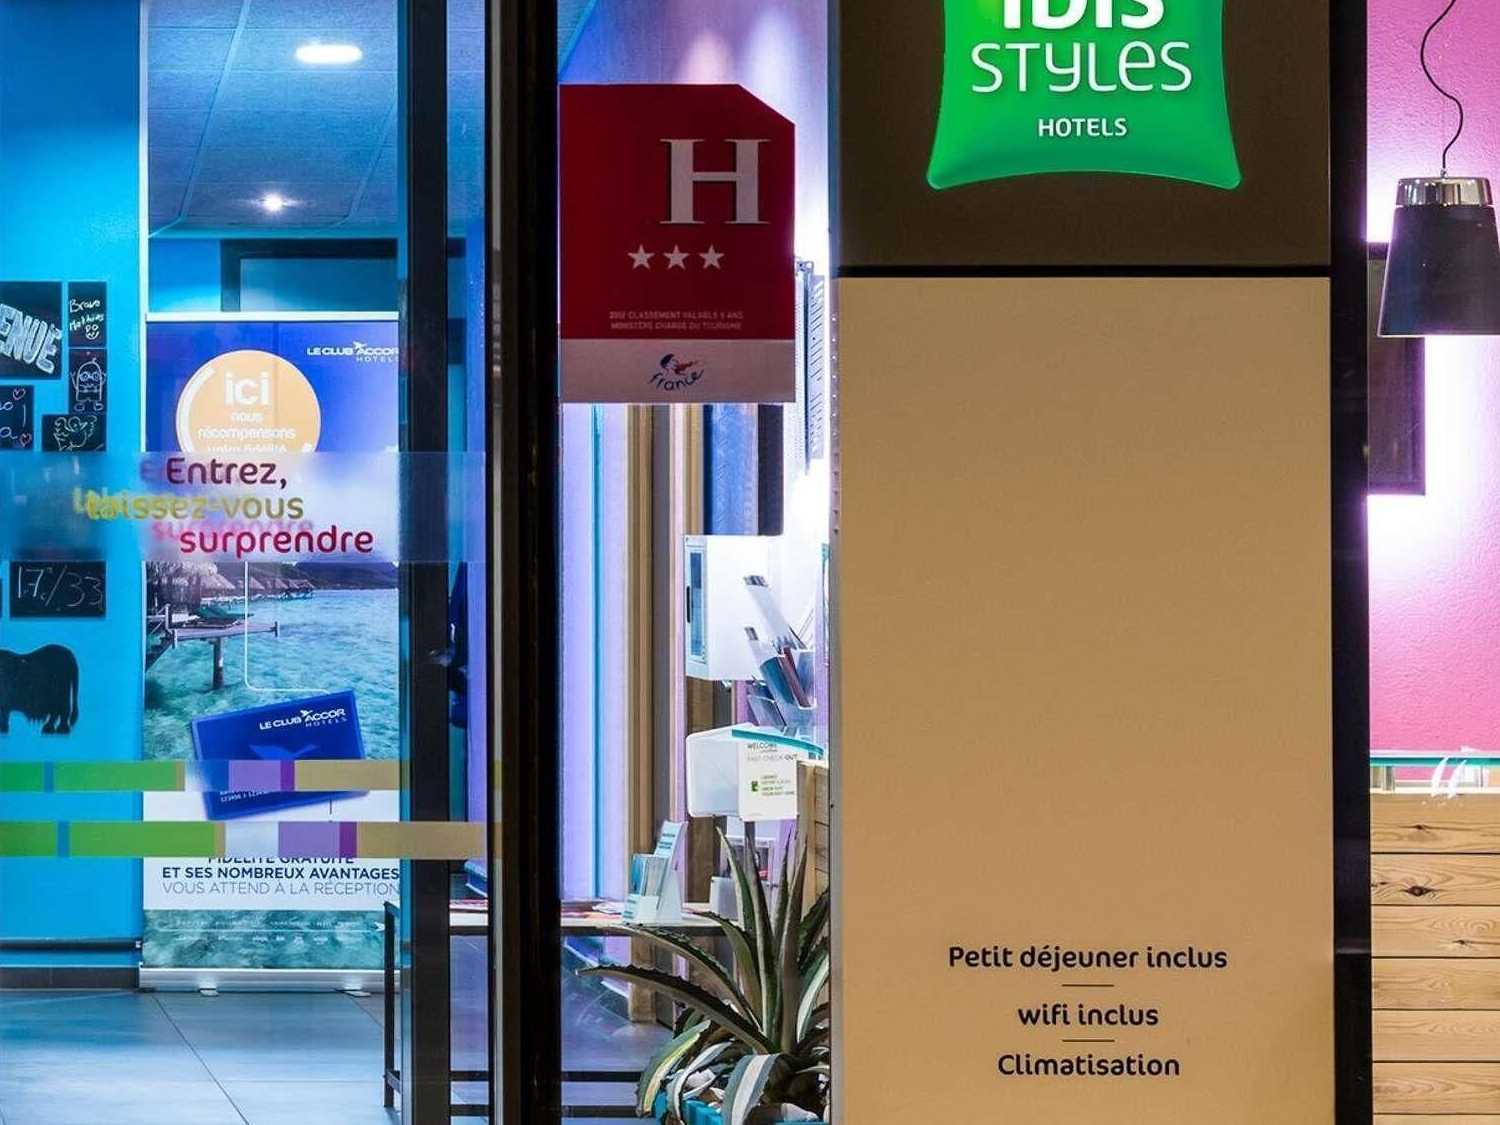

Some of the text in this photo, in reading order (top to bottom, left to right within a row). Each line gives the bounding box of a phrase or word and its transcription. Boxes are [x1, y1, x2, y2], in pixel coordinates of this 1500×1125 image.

[1037, 117, 1128, 138] HOTELS
[659, 138, 771, 225] H
[321, 347, 354, 355] CLUB
[225, 371, 270, 406] ici
[231, 412, 263, 424] nous
[166, 457, 287, 490] Entrez,
[180, 525, 374, 559] surprendre
[259, 708, 346, 730] LE CLUB ACCOR
[162, 867, 400, 880] ET SES NOMBREUX AVANTAGES
[162, 881, 205, 894] VOUS
[210, 881, 270, 894] ATTEND
[290, 882, 309, 894] LA
[949, 945, 1228, 972] Petit déjeuner inclus
[1018, 1004, 1159, 1026] wifi inclus
[997, 1053, 1181, 1076] Climatisation
